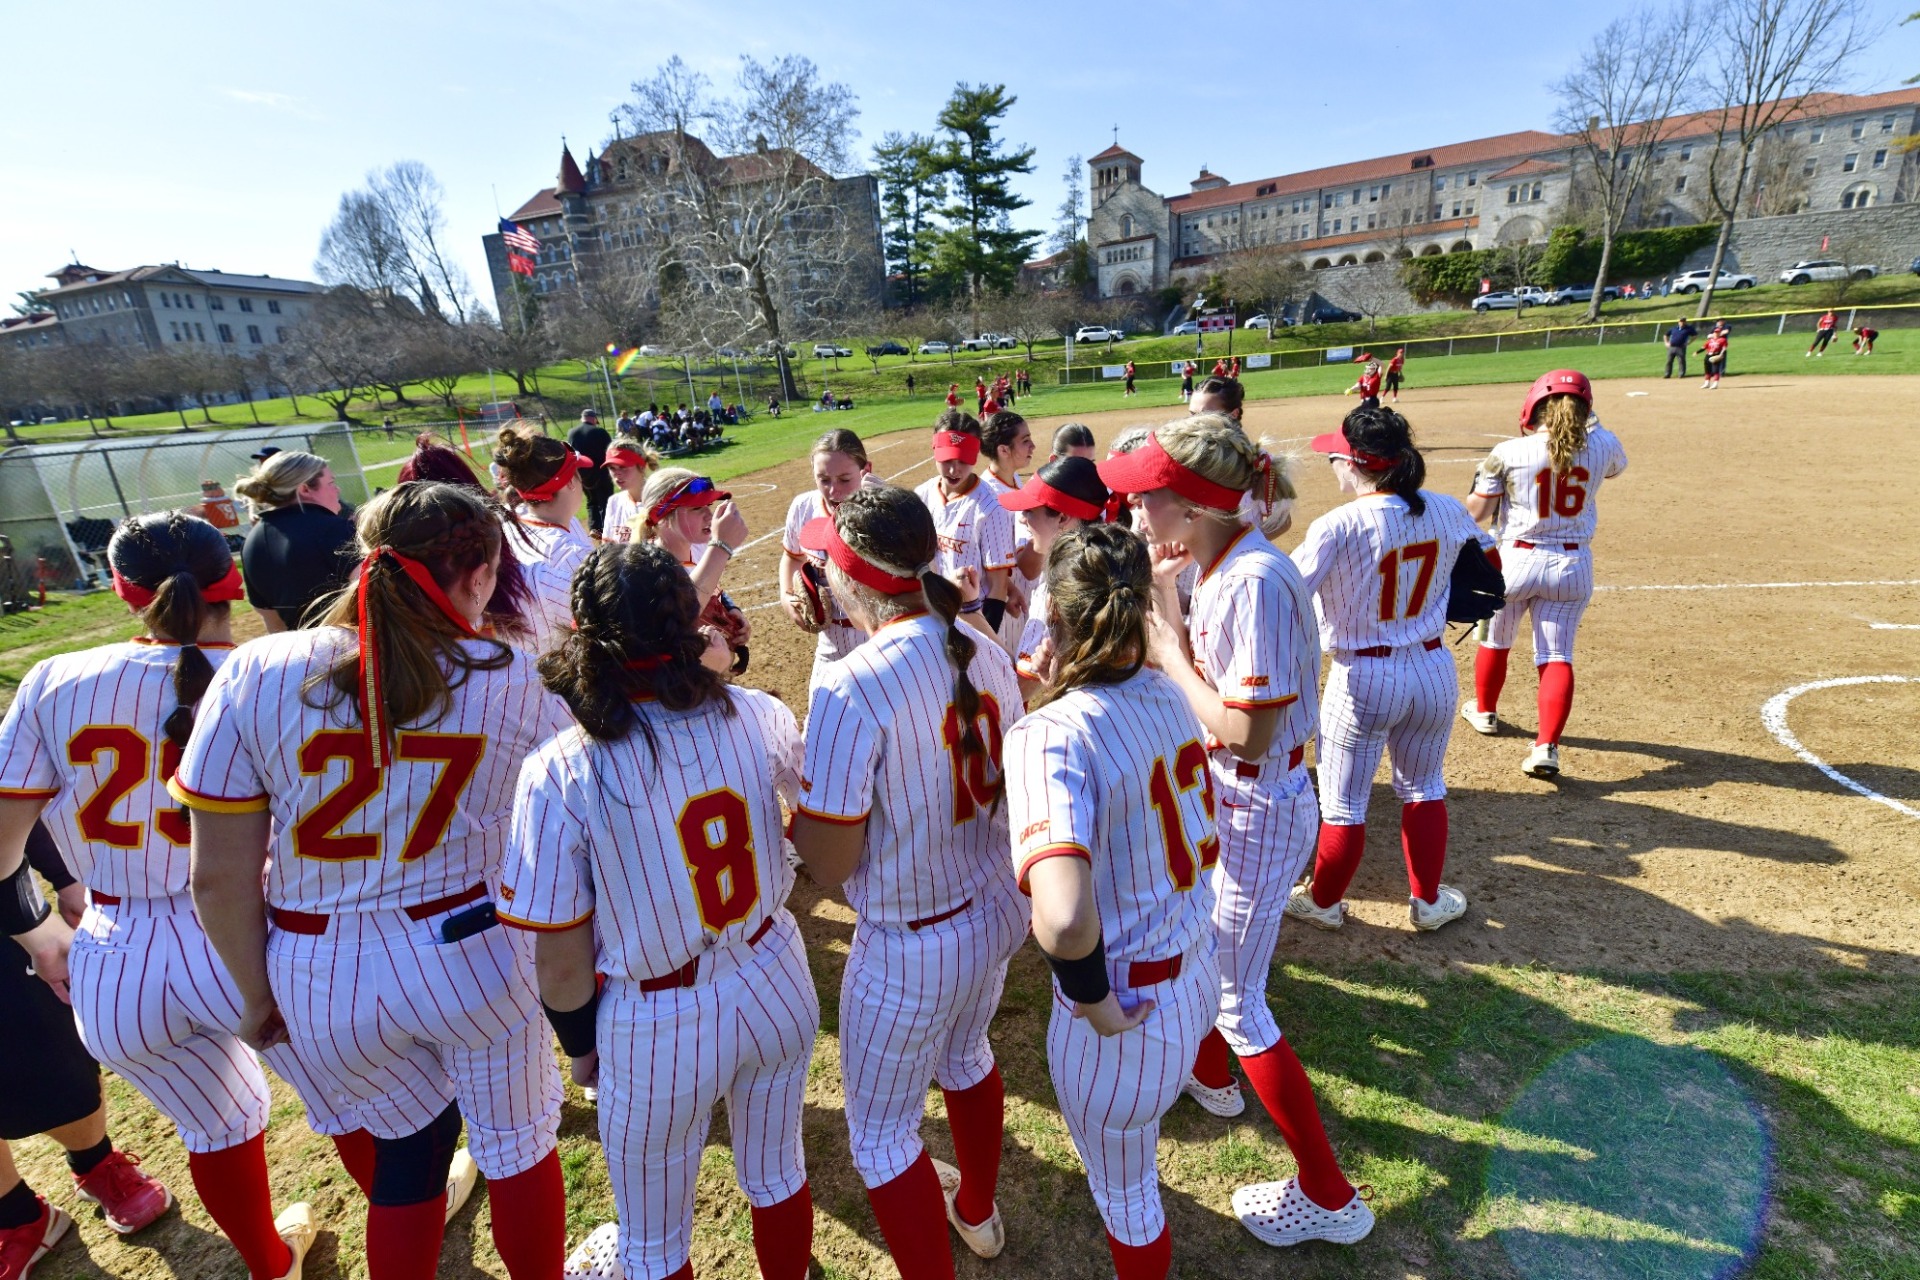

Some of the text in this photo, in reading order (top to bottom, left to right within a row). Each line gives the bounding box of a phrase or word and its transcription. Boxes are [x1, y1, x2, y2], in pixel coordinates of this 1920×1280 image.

[1535, 466, 1590, 519] 16
[1378, 539, 1440, 622] 17
[291, 729, 488, 863] 27
[940, 690, 1004, 826] 10
[1149, 737, 1220, 892] 13
[675, 786, 760, 935] 8
